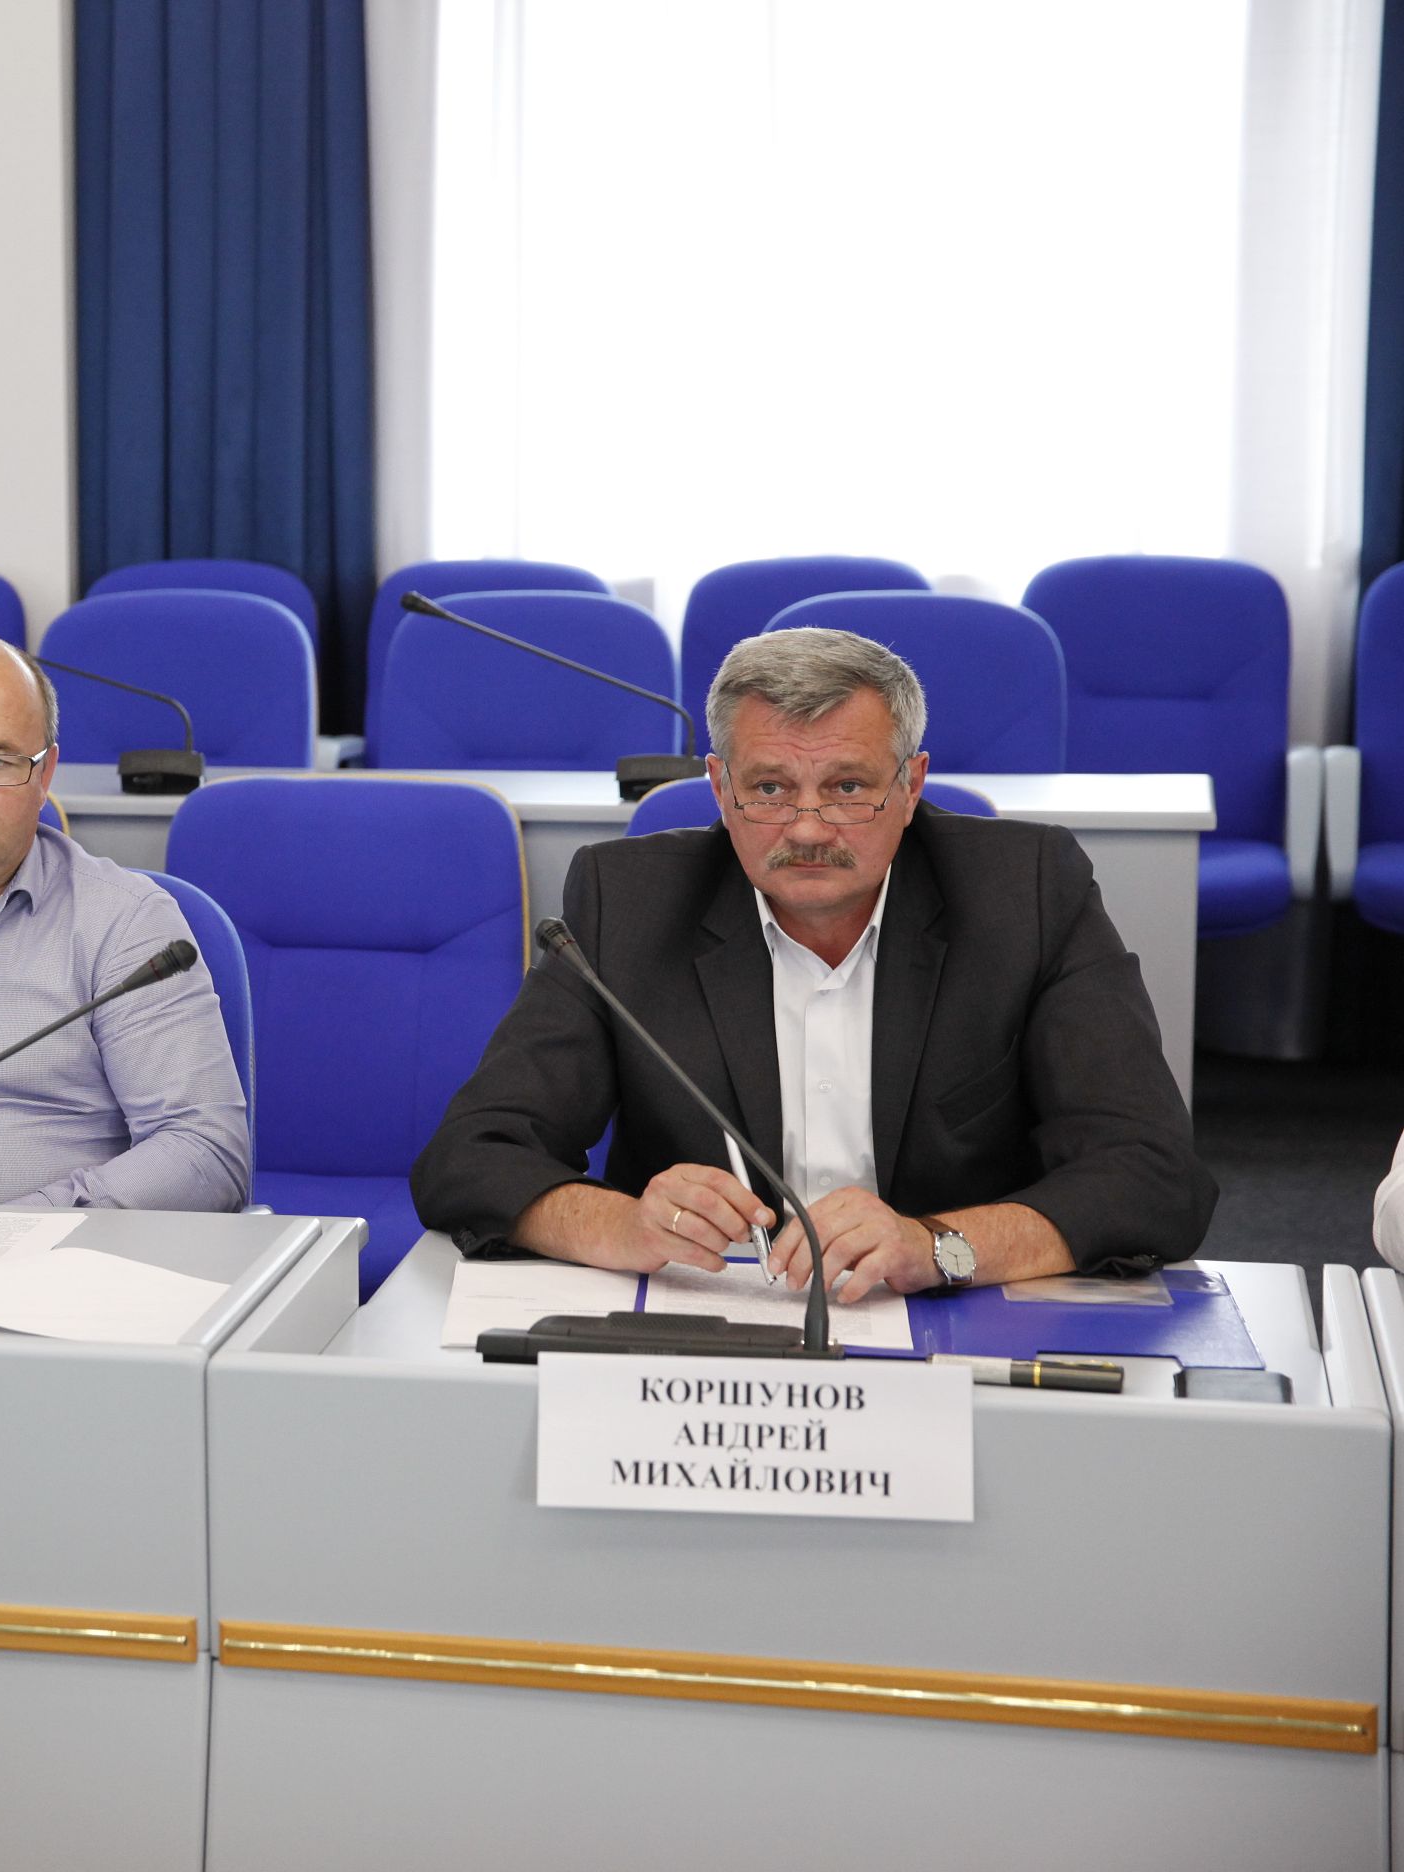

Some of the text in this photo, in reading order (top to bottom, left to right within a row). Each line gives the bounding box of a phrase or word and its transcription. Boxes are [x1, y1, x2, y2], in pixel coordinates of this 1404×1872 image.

[640, 1376, 865, 1411] КОРШУНОВ
[673, 1418, 827, 1453] АНДРЕЙ
[609, 1457, 892, 1498] МИХАЙЛОВИЧ
